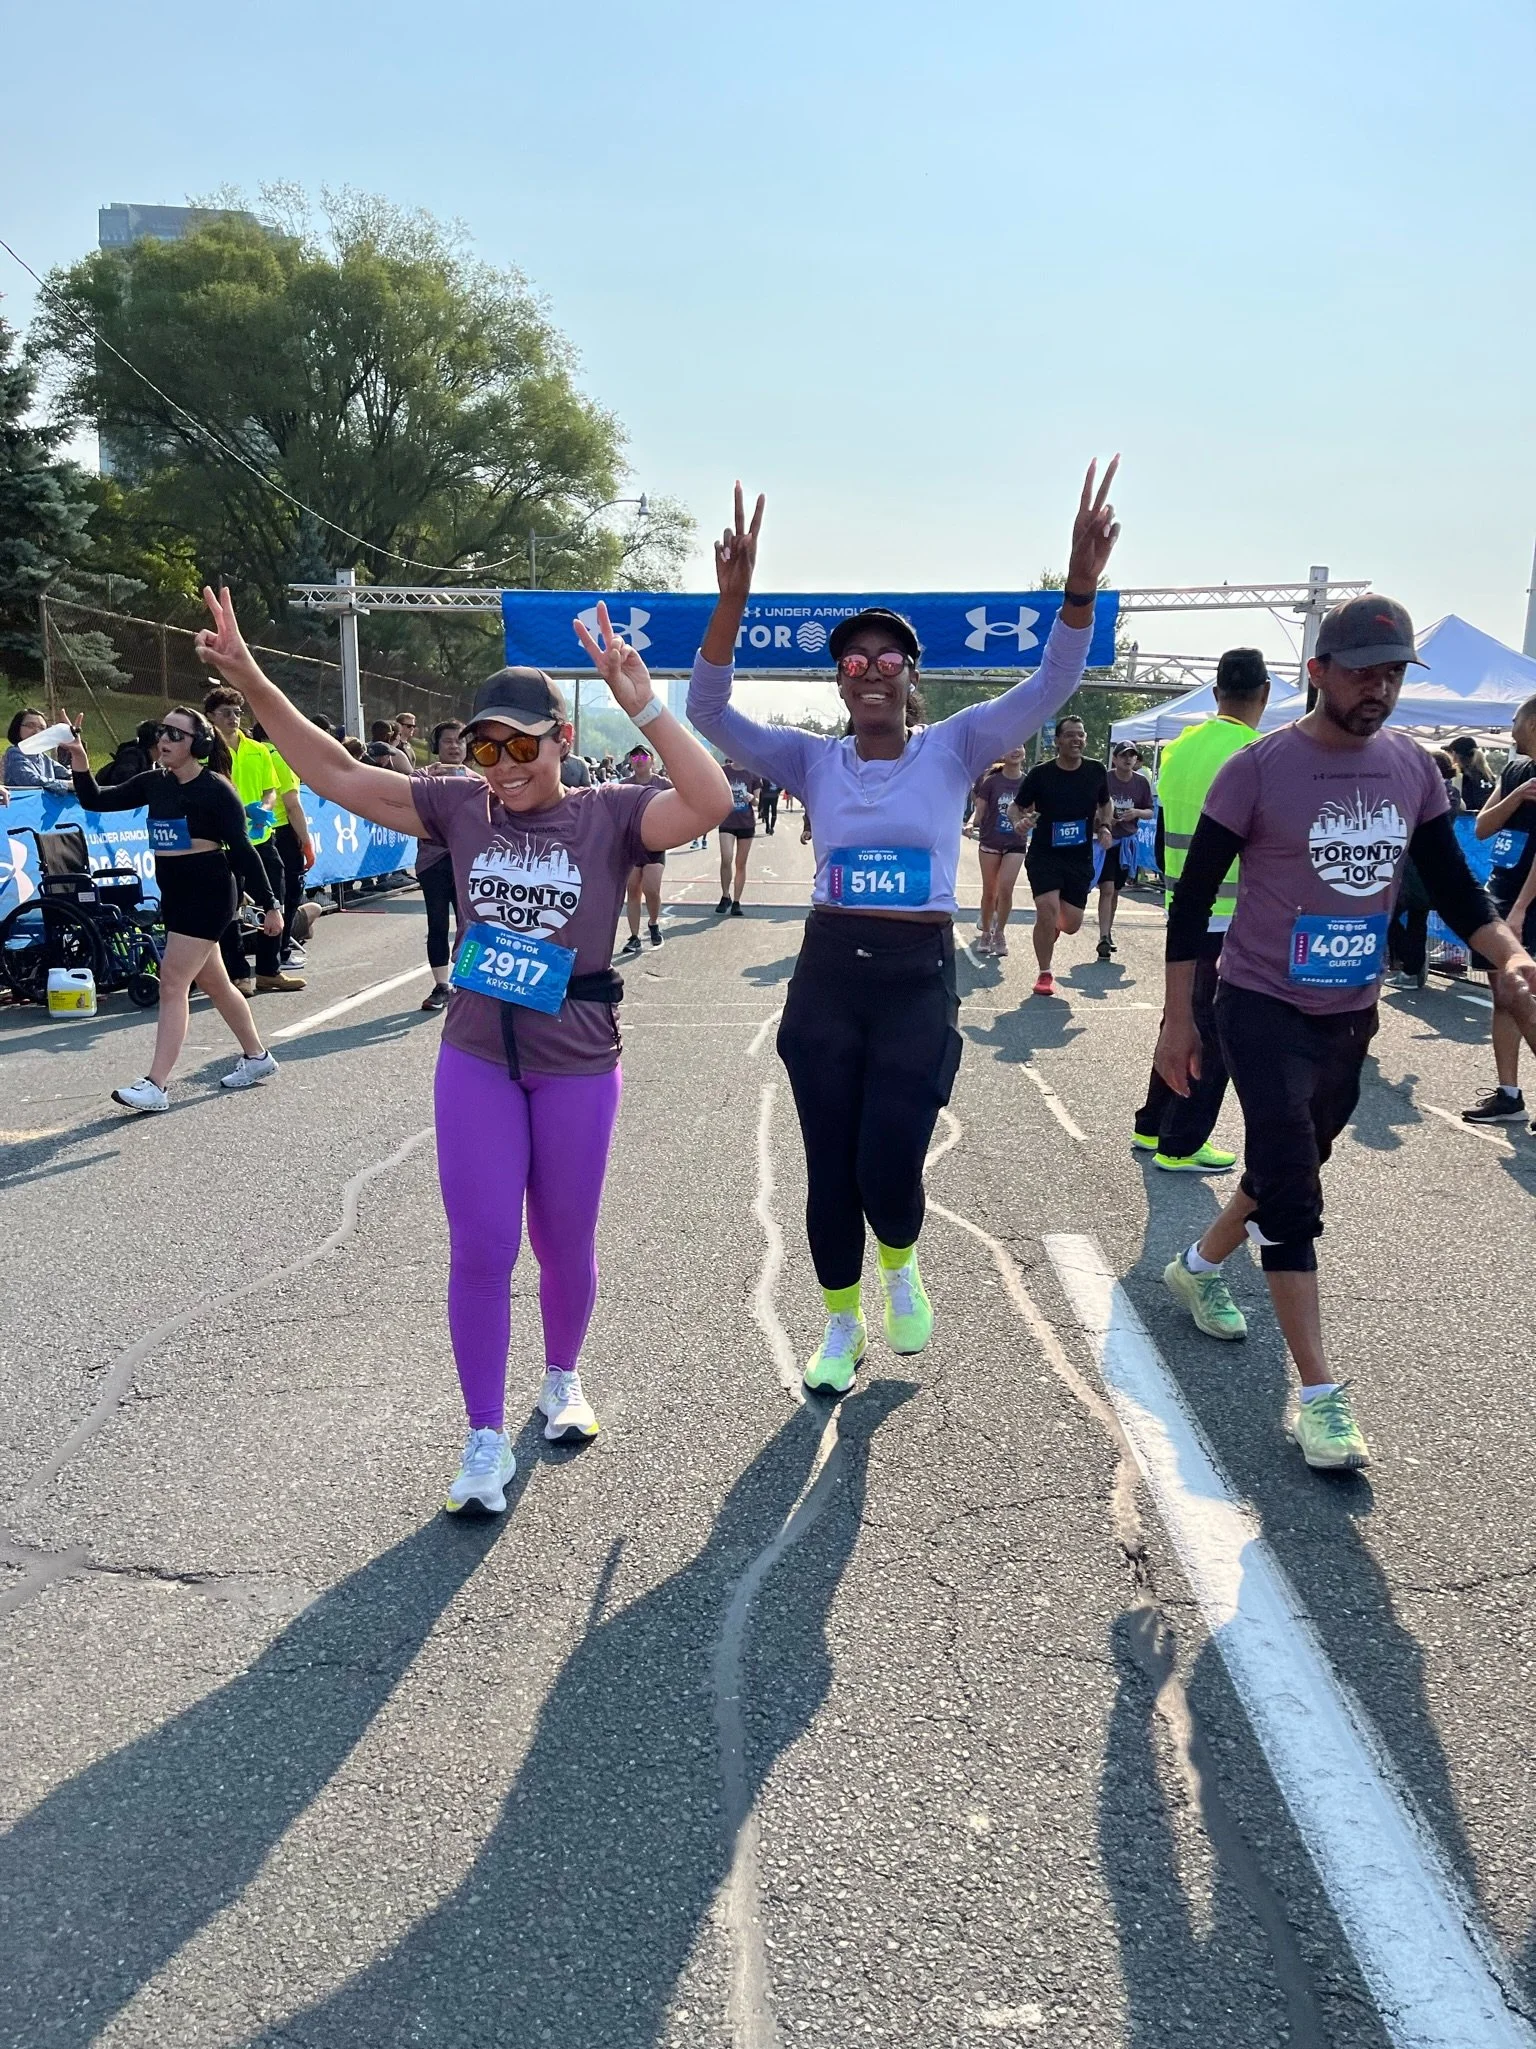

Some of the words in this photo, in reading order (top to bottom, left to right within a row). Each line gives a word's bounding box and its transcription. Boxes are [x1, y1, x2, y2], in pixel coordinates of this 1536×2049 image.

[765, 607, 811, 617] UNDER
[813, 607, 867, 617] ARMOU
[735, 625, 792, 648] TOR
[89, 831, 118, 844] UNDER
[119, 829, 149, 841] ARMOU
[1060, 826, 1079, 837] 1671
[1311, 845, 1402, 862] TORONTO
[851, 871, 905, 893] 5141
[1342, 866, 1378, 882] 10K
[470, 878, 577, 909] TORONTO
[497, 904, 541, 927] 10K
[495, 936, 512, 947] TOR
[522, 943, 540, 955] 10K
[1311, 933, 1377, 957] 4028
[478, 947, 548, 986] 2917
[1329, 959, 1361, 967] GURTEJ
[486, 976, 527, 995] KRYSTAL
